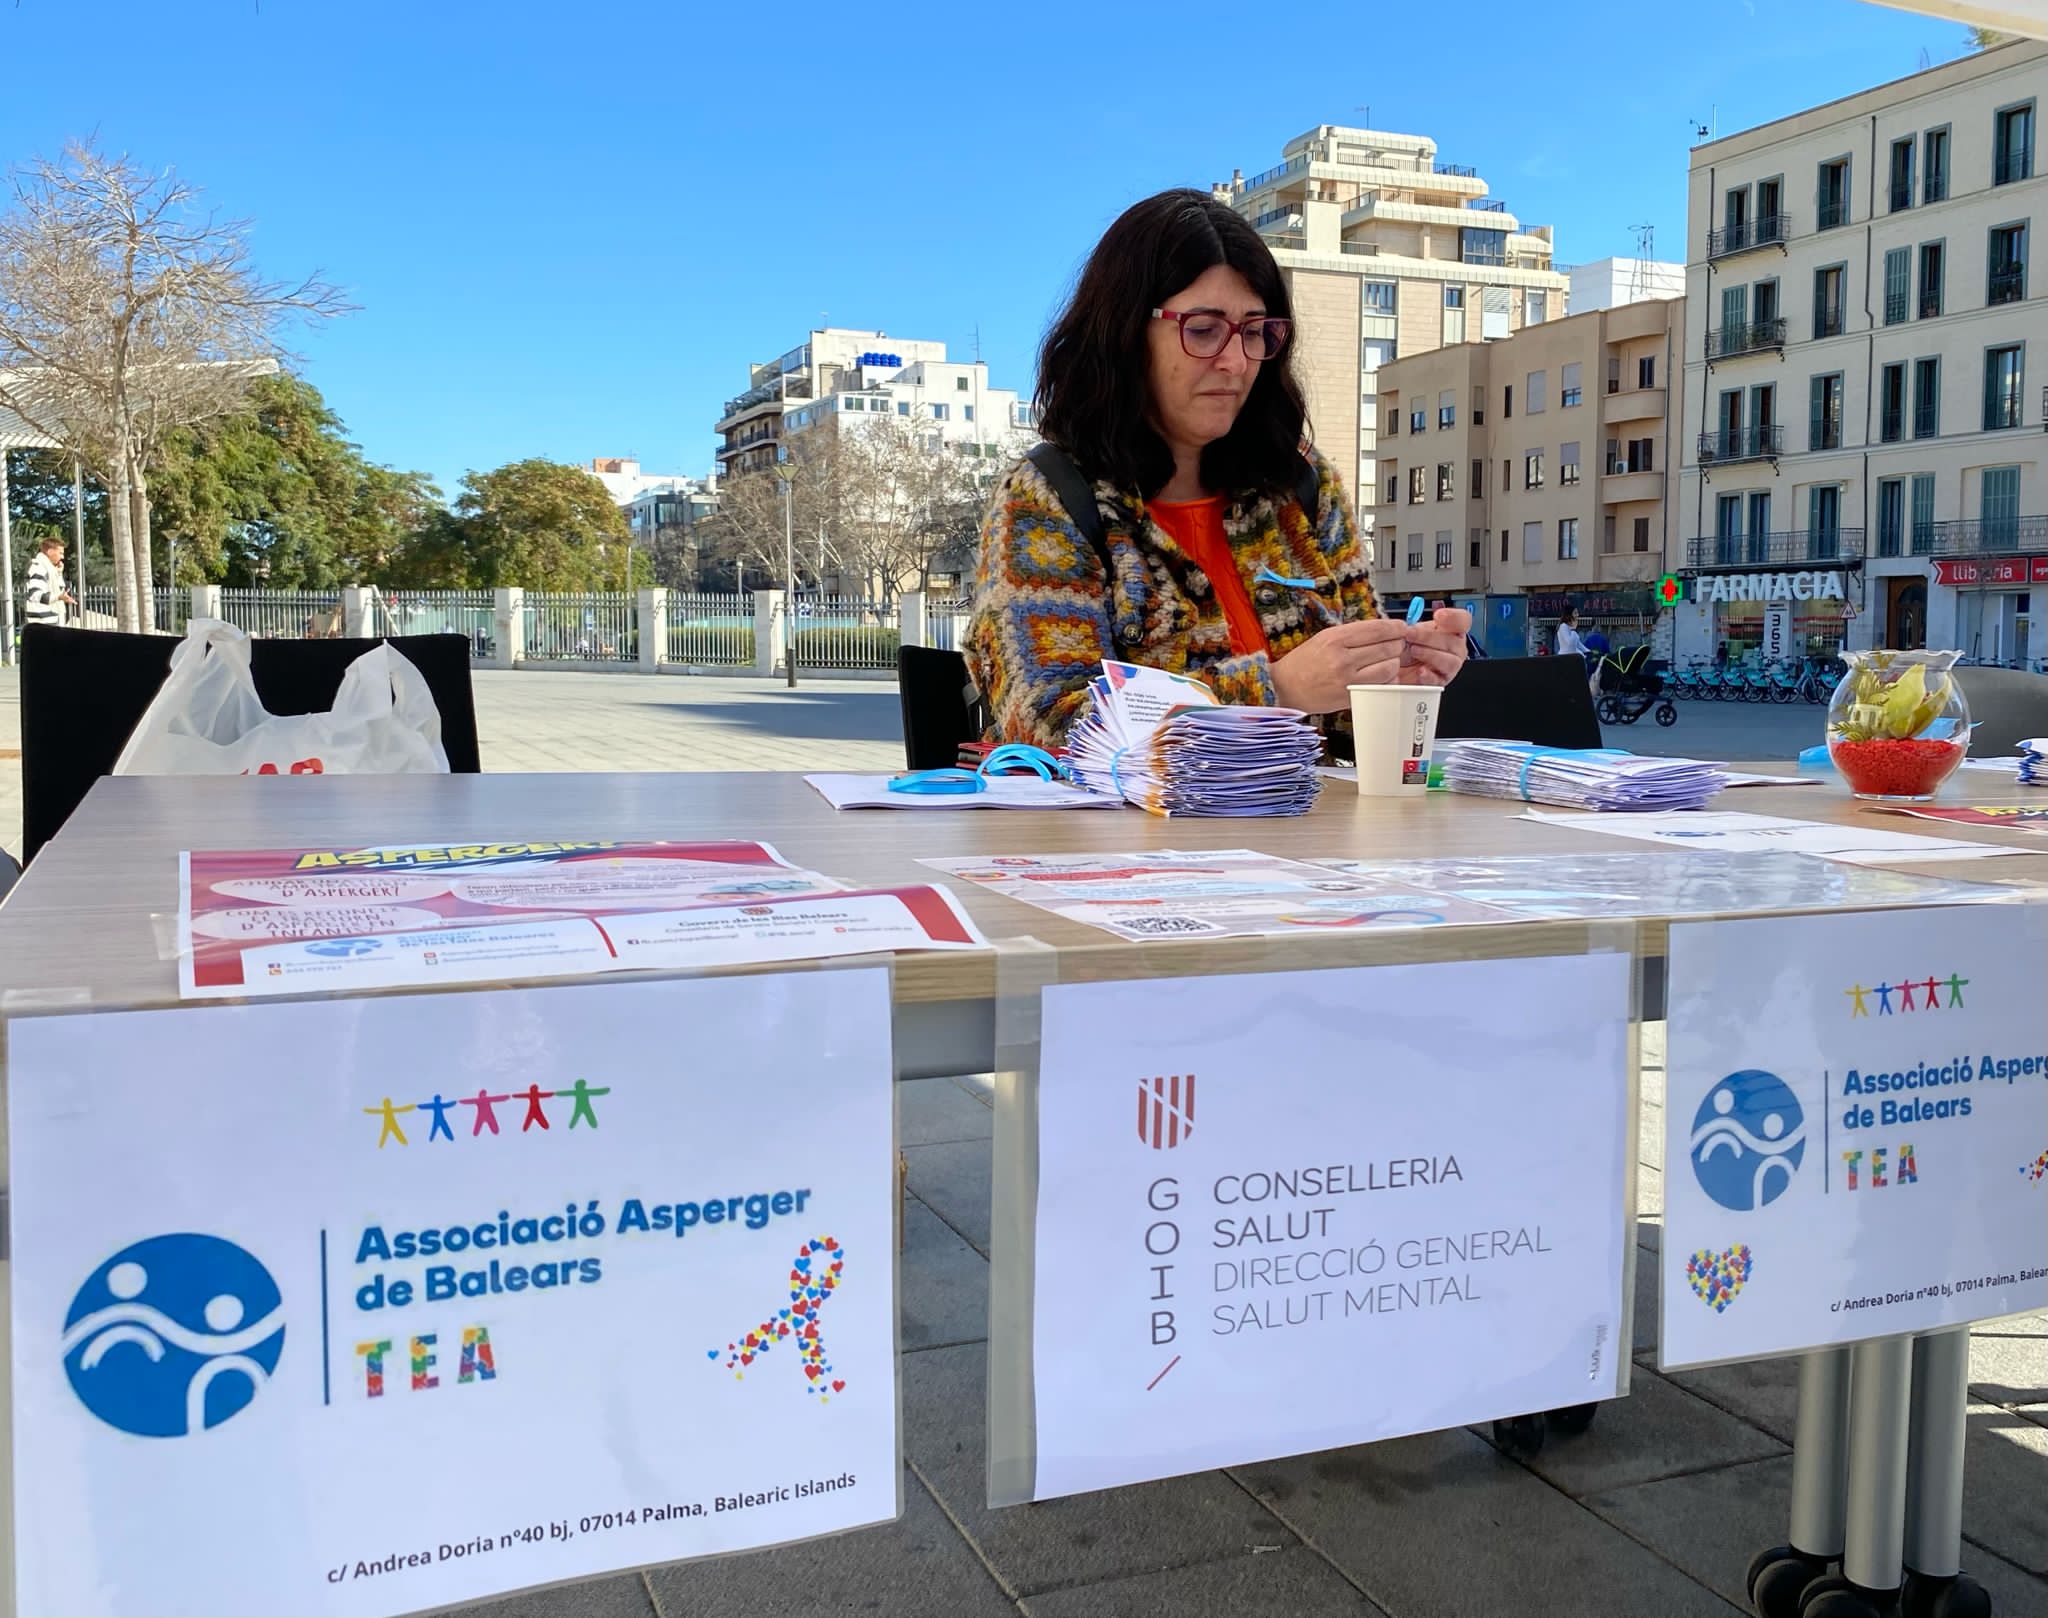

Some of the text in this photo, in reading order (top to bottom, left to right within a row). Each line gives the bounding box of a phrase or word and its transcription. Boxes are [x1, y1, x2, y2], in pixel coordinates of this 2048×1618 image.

[1697, 570, 1846, 602] FARMACIA
[1771, 614, 1781, 655] 365
[1844, 1056, 1974, 1096] Associació
[1843, 1097, 1972, 1129] de Balears
[1213, 1155, 1464, 1205] CONSELLERIA
[1843, 1144, 1918, 1191] TEA
[355, 1188, 812, 1264] Associació Asperger
[1213, 1209, 1336, 1248] SALUT
[1214, 1226, 1553, 1292] DIRECCIÓ GENERAL
[355, 1257, 603, 1311] de Balears
[1212, 1274, 1482, 1335] SALUT MENTAL
[1831, 1301, 1841, 1312] c/
[1844, 1296, 1883, 1311] Andrea
[1886, 1290, 1914, 1305] Doria
[1956, 1278, 1984, 1293] 07014
[1986, 1273, 2018, 1288] Palma,
[356, 1327, 497, 1397] TEA
[327, 1565, 348, 1583] c/
[353, 1554, 431, 1579] Andrea
[438, 1537, 493, 1561] Doria
[550, 1520, 574, 1541] bj,
[579, 1510, 637, 1533] 07014
[642, 1503, 709, 1524] Palma,
[714, 1487, 790, 1513] Balearic
[795, 1472, 857, 1498] Islands
